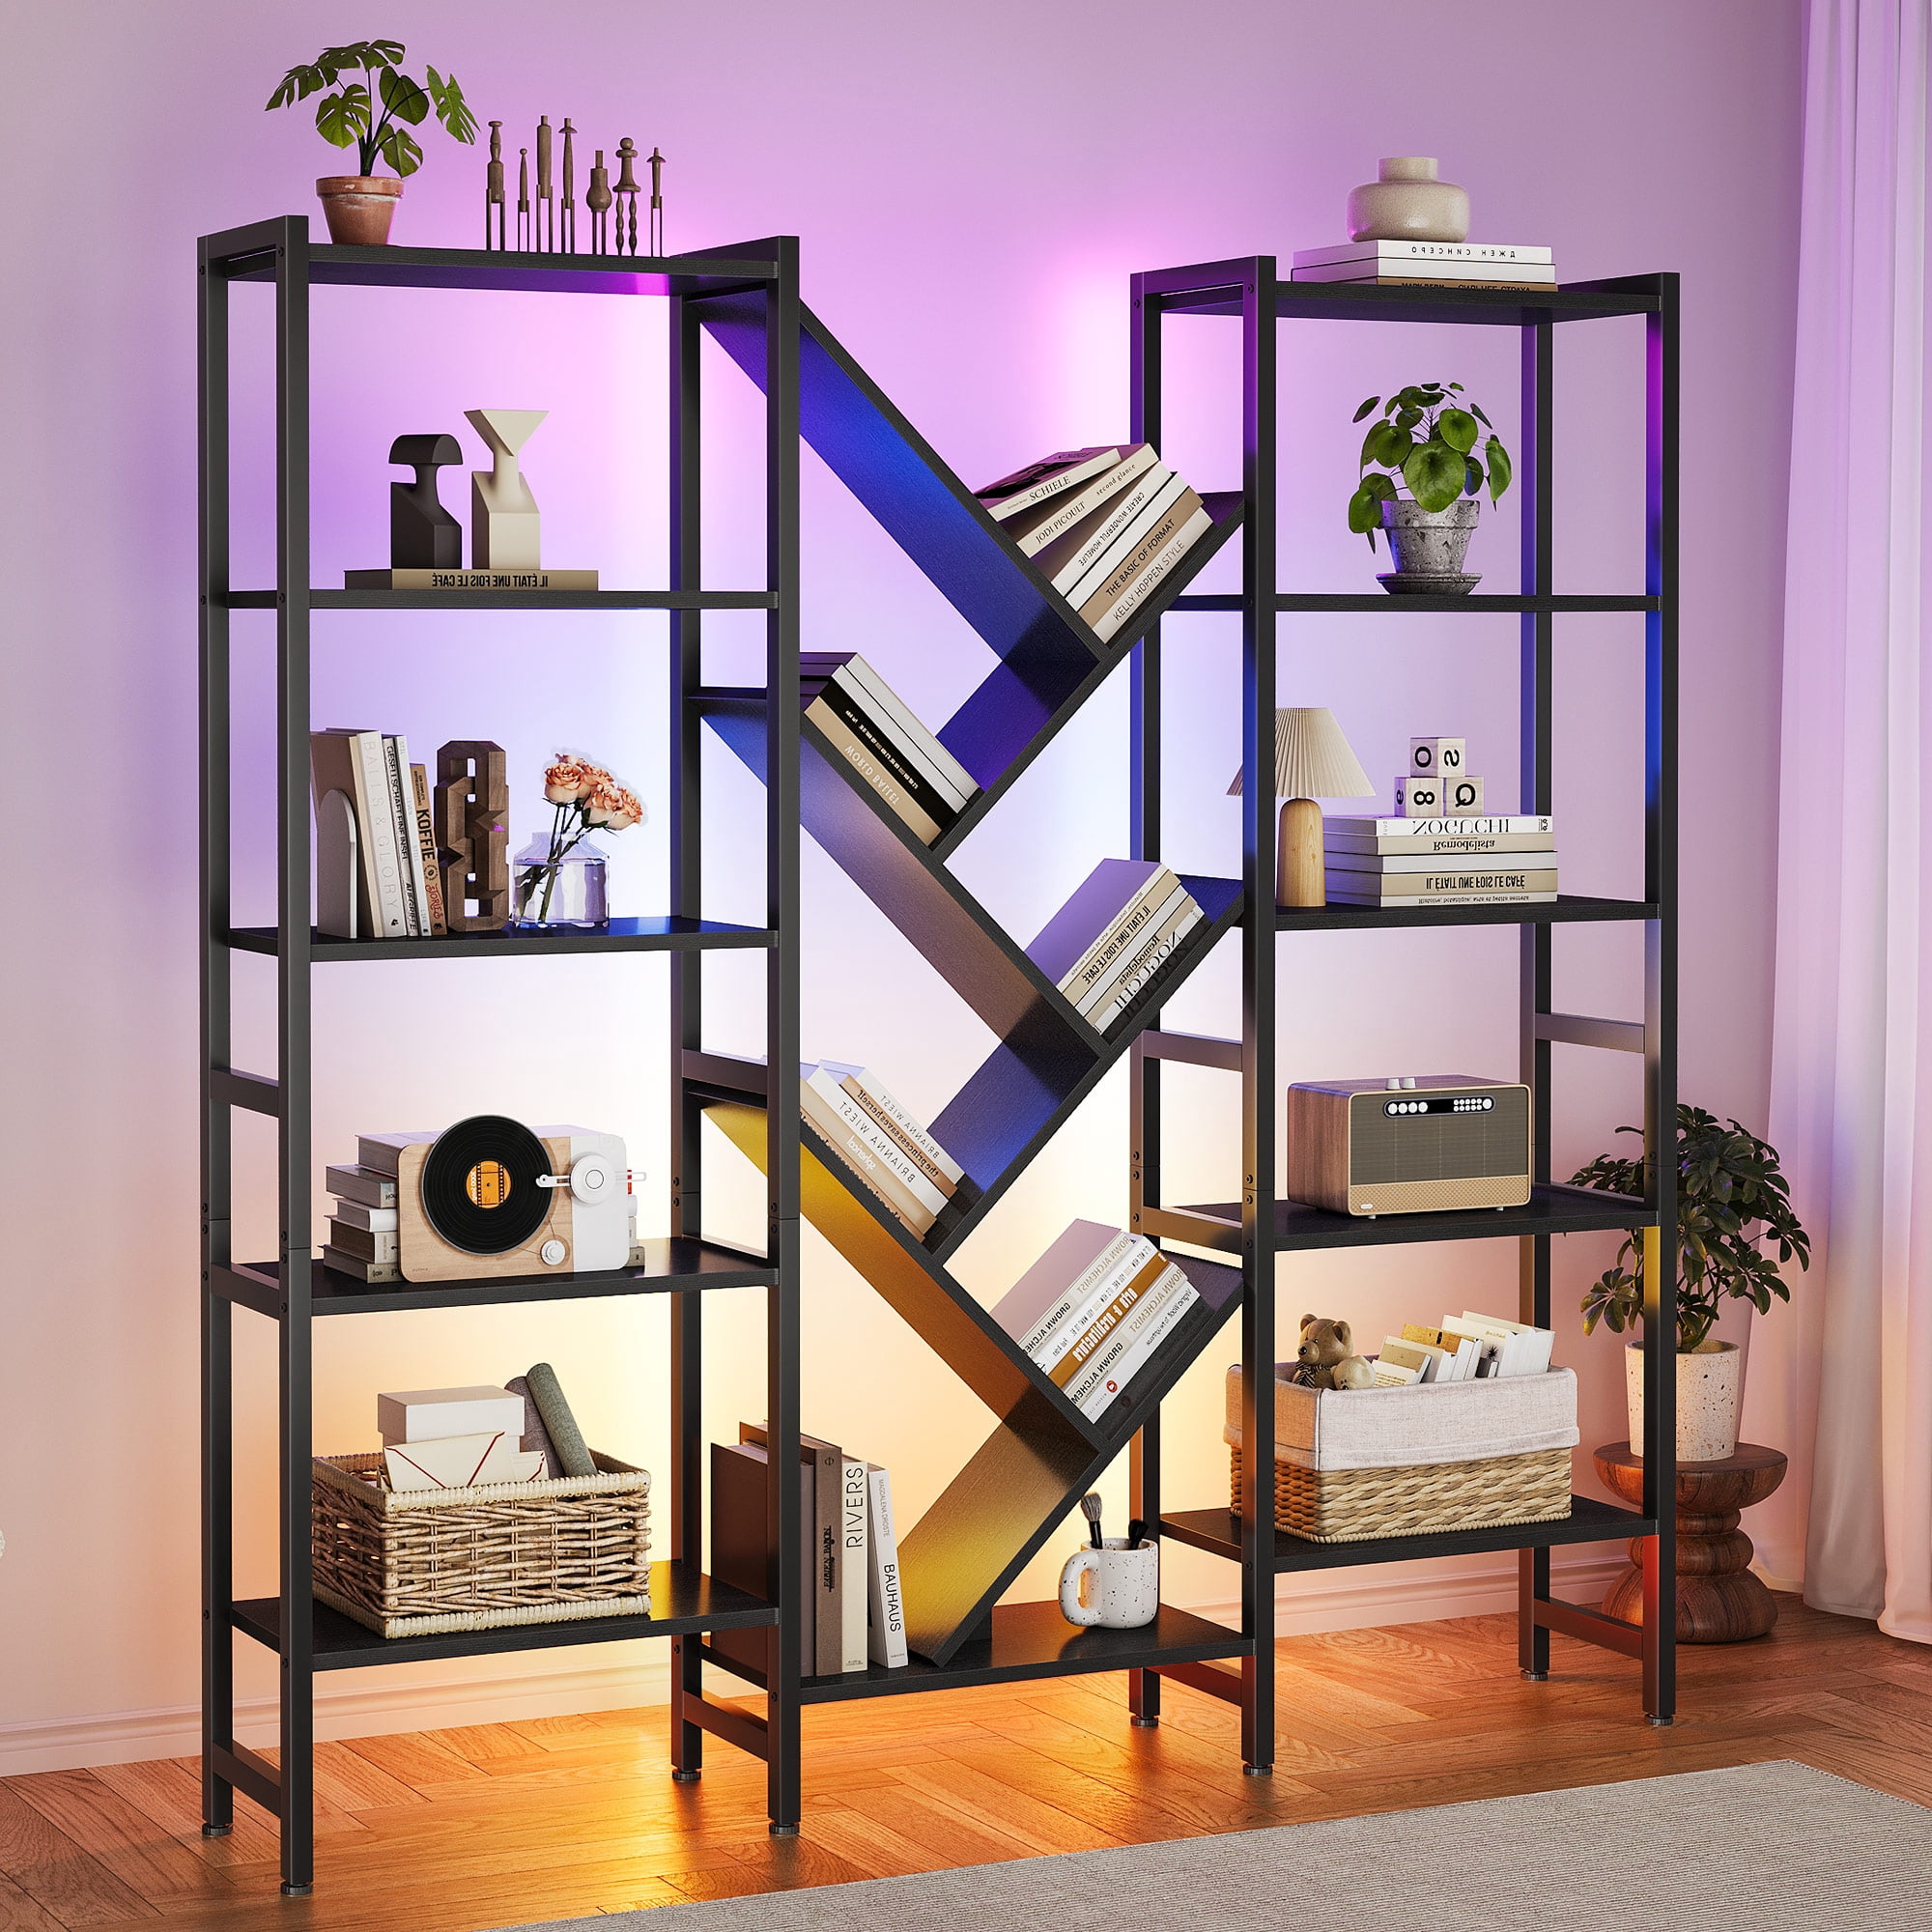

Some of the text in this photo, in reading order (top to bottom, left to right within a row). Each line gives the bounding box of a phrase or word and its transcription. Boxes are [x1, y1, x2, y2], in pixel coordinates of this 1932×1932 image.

[1029, 475, 1072, 501] SCHIELE
[1095, 464, 1135, 496] second glance
[1036, 526, 1054, 545] JODI
[1053, 501, 1085, 529] PICOULT
[1078, 492, 1145, 567] CREATE WONDERFUL HOMELIFE
[1105, 519, 1175, 596] THE BASIC OF FORMAT
[1113, 540, 1184, 621] KELLY HOPPEN STYLE
[416, 808, 436, 862] KOFFIE
[378, 836, 399, 908] GLORY
[425, 882, 443, 920] STORIES
[845, 1466, 864, 1548] RIVERS
[883, 1563, 901, 1633] BAUHAUS
